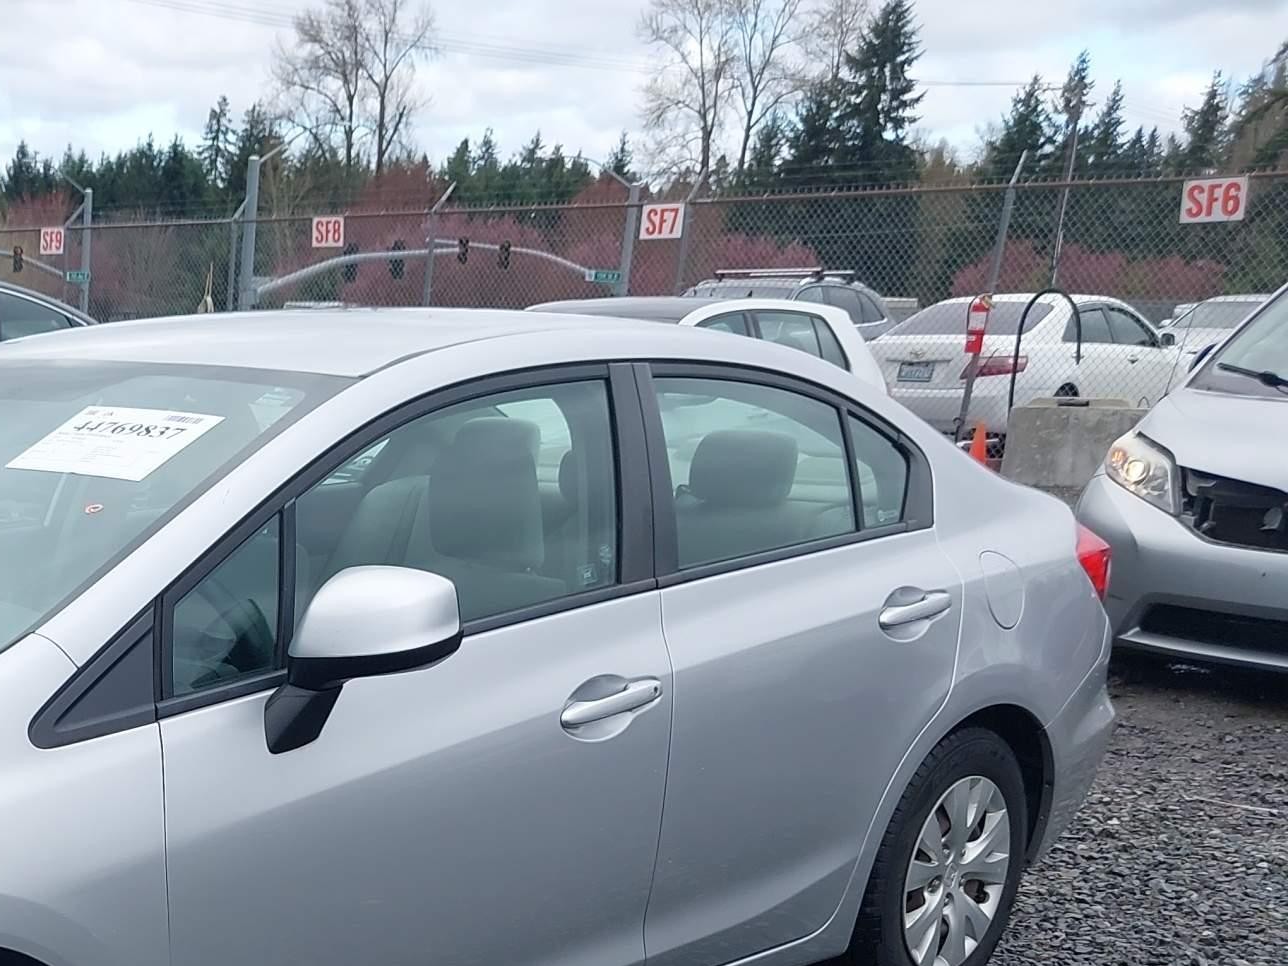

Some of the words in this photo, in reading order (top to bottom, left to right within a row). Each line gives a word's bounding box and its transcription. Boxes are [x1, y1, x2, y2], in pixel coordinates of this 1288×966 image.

[1185, 182, 1241, 218] SF6
[315, 220, 341, 244] SF8
[645, 207, 679, 236] SF7
[42, 230, 62, 251] SF9
[73, 420, 187, 439] 44769837
